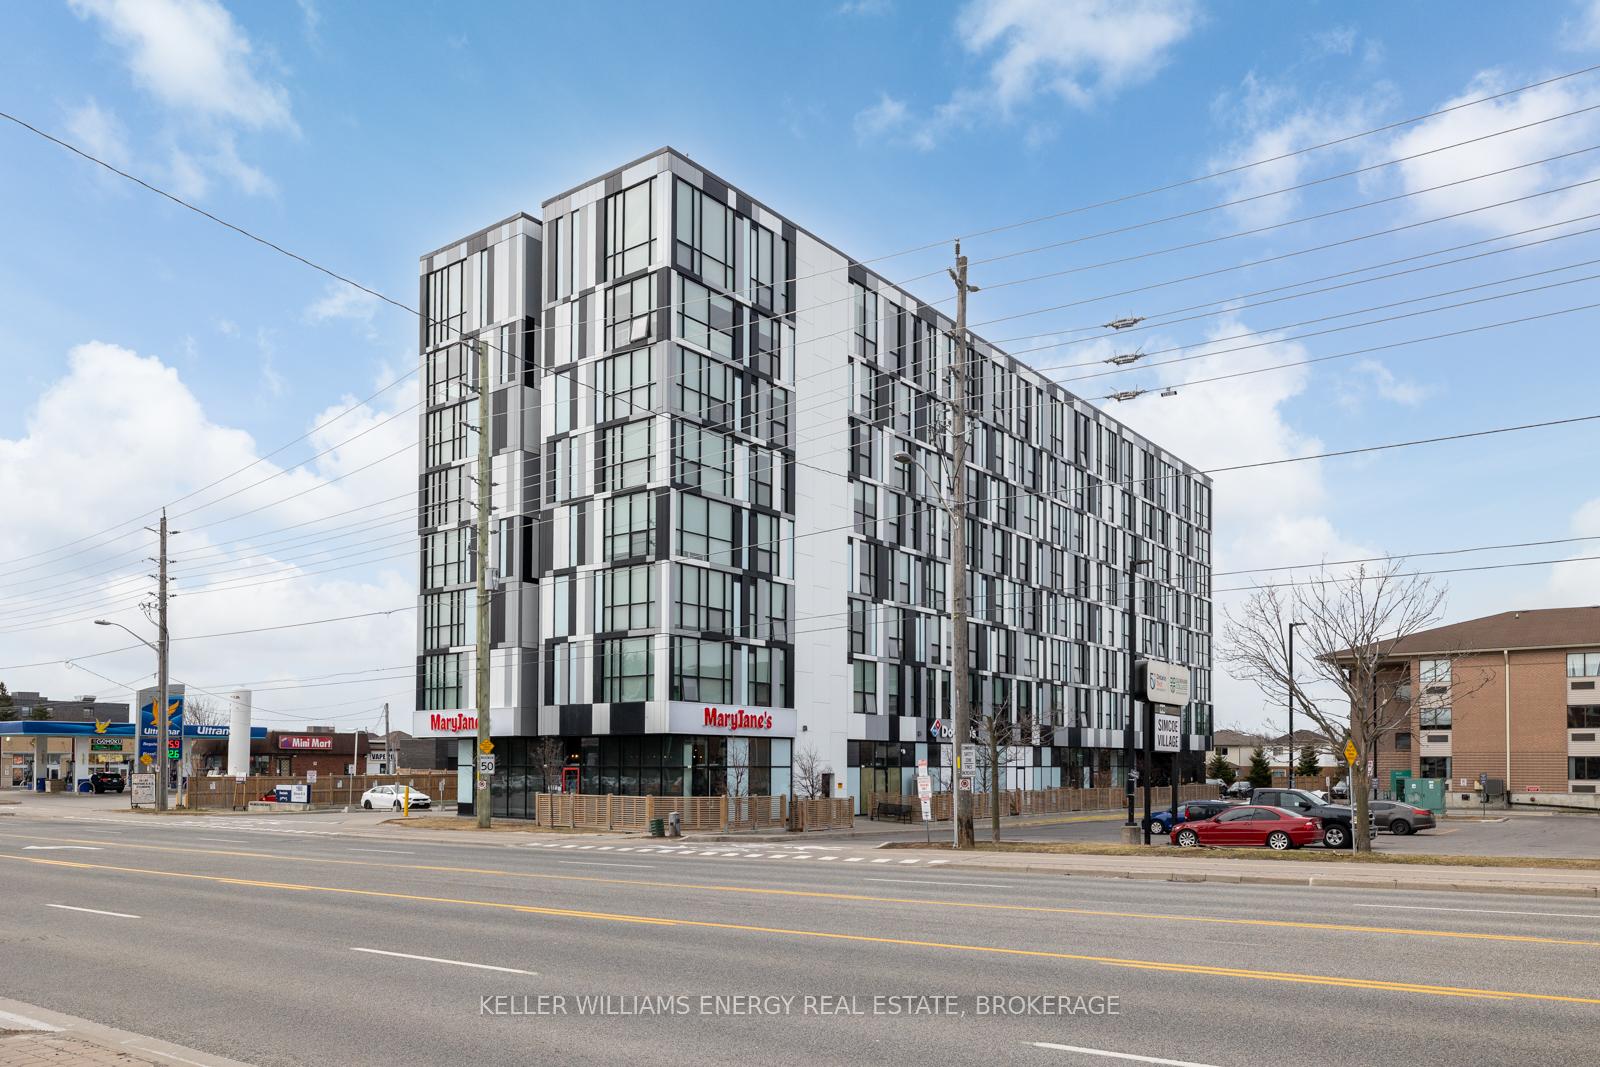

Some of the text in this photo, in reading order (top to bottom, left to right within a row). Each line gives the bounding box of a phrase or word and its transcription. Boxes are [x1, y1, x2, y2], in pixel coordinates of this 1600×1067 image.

[431, 713, 479, 732] MaryJan
[704, 707, 772, 731] MaryJane's
[1157, 719, 1178, 733] SIMCOE
[292, 738, 331, 748] Mini Mart
[1157, 735, 1178, 748] VILLAGE
[481, 761, 494, 771] 50
